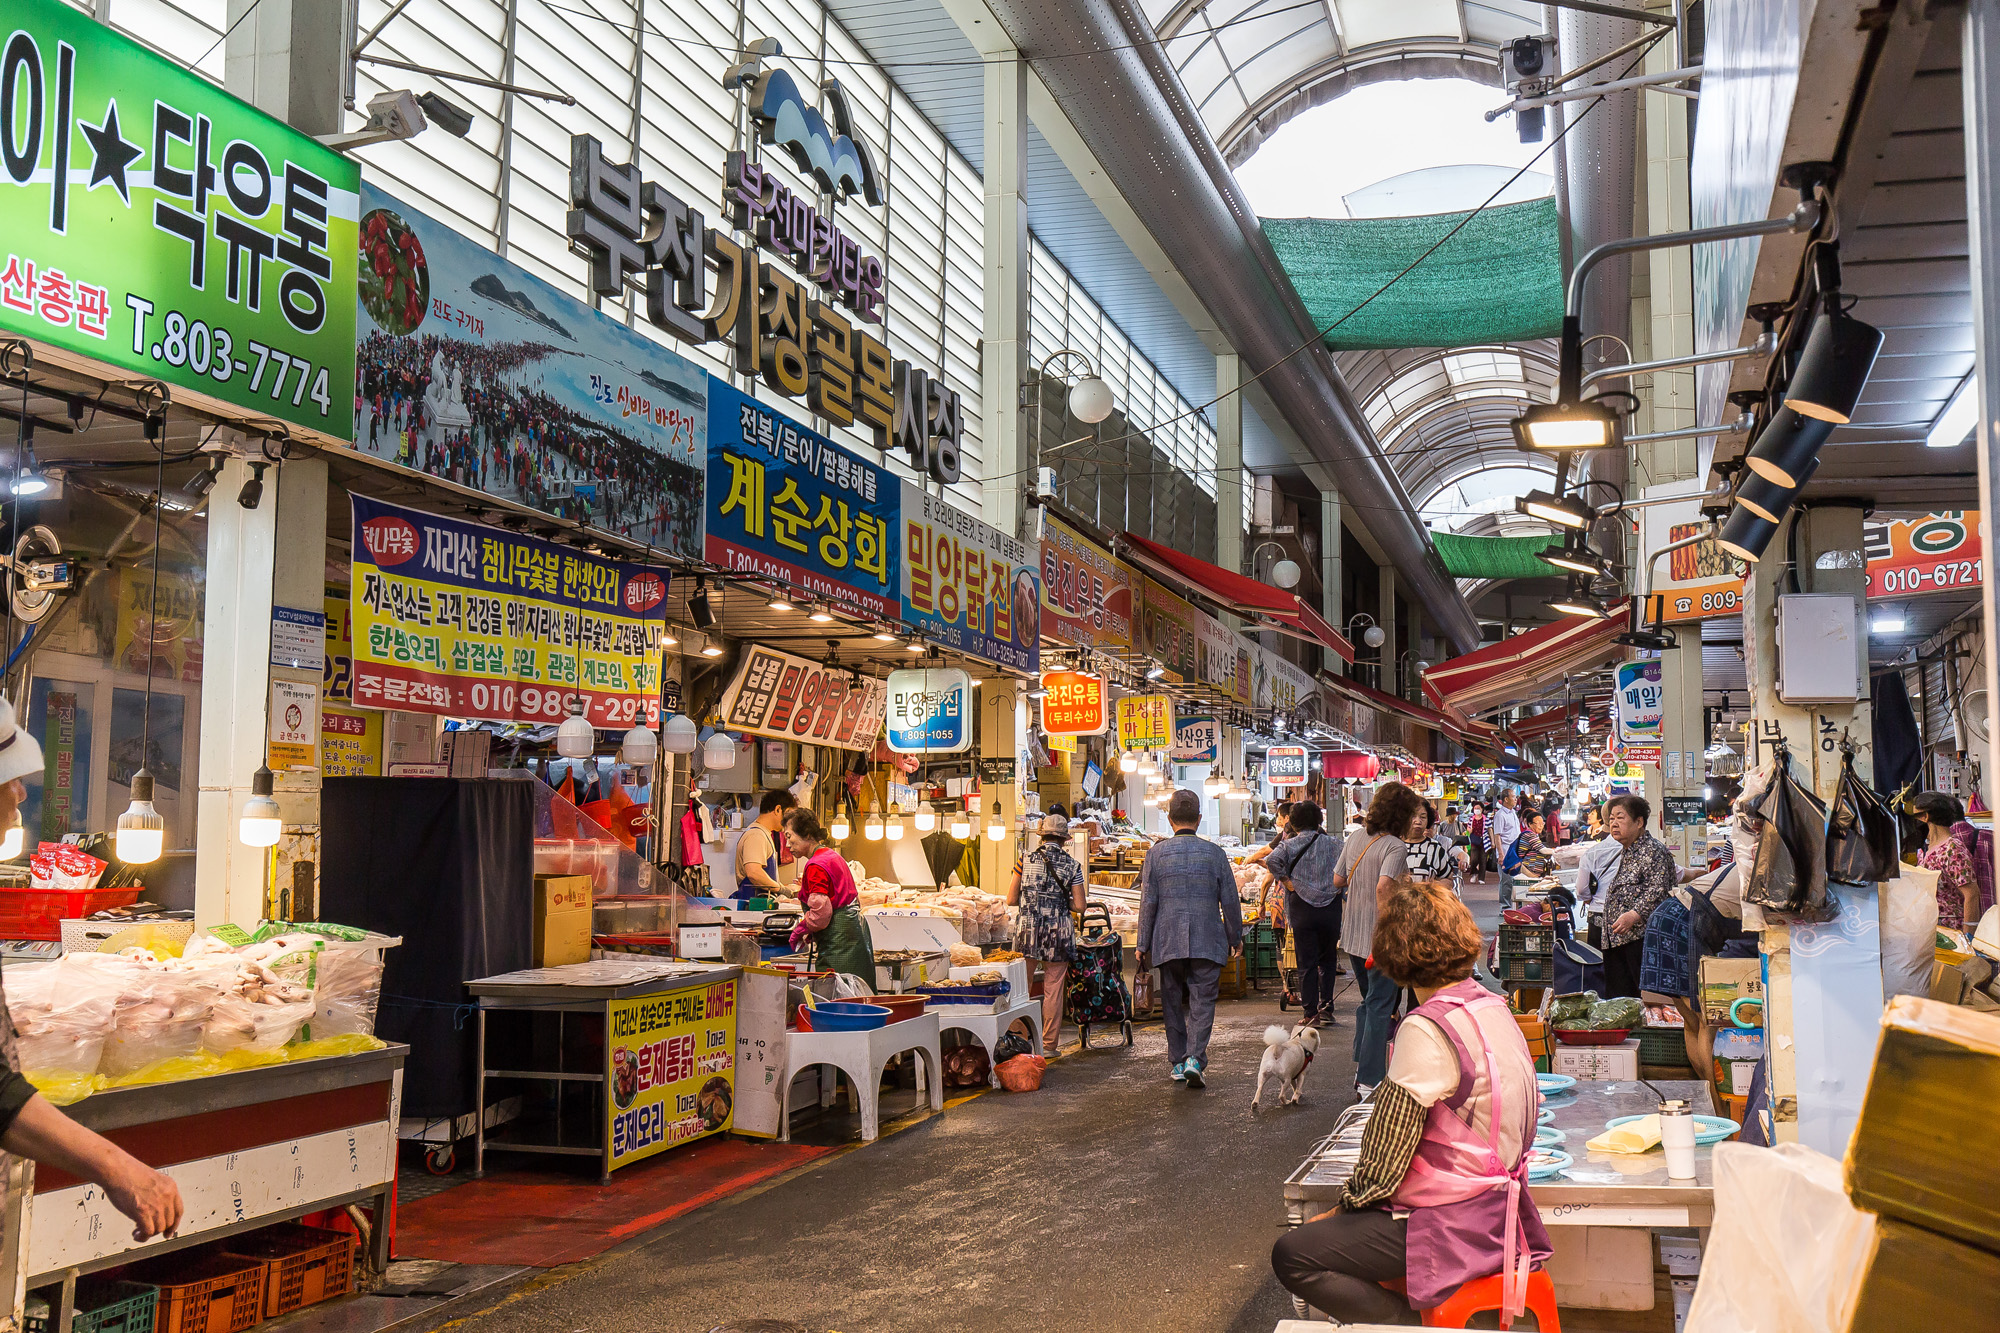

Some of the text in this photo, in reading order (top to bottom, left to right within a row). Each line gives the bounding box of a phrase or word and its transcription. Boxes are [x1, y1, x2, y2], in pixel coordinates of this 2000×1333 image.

[722, 149, 884, 324] 부전마켓타운
[432, 297, 485, 339] 진도 구기자
[125, 292, 333, 418] T.803-7774
[616, 385, 651, 423] 신비의
[654, 405, 696, 454] 바닷길
[740, 402, 877, 503] 전복/문어/짬뽕해물
[720, 452, 887, 584] 계순상회
[422, 525, 620, 607] 지리산 참나무숯불 한방오리
[907, 518, 1012, 642] 밀양닭집
[1045, 547, 1104, 631] 한진유통
[1702, 592, 1743, 611] 809-
[436, 591, 462, 632] 고객
[466, 594, 502, 635] 건강을
[526, 606, 562, 645] 지리산
[633, 663, 658, 691] 잔치
[1209, 645, 1235, 693] 선산유통
[358, 674, 451, 708] 주문전화
[668, 696, 677, 708] 23
[895, 691, 959, 718] 밀양닭집
[1046, 683, 1099, 707] 한진유통
[57, 707, 74, 745] 진도
[342, 718, 362, 733] 효능
[1049, 709, 1098, 725] (두리수산)
[1123, 701, 1164, 719] 고성닭
[898, 729, 953, 741] T.809-1055
[56, 751, 73, 789] 발효
[325, 764, 347, 775] 영양을
[345, 753, 373, 765] 아이들이
[1270, 757, 1303, 773] 양산유통
[613, 1006, 637, 1038] 지리산
[674, 994, 704, 1026] 구워내는
[705, 982, 734, 1020] 바베큐
[706, 1029, 726, 1049] 1마리
[637, 1032, 696, 1094] 훈제통닭
[676, 1093, 697, 1114] 1마리
[613, 1100, 665, 1159] 훈제오리
[346, 1138, 358, 1173] DKCS
